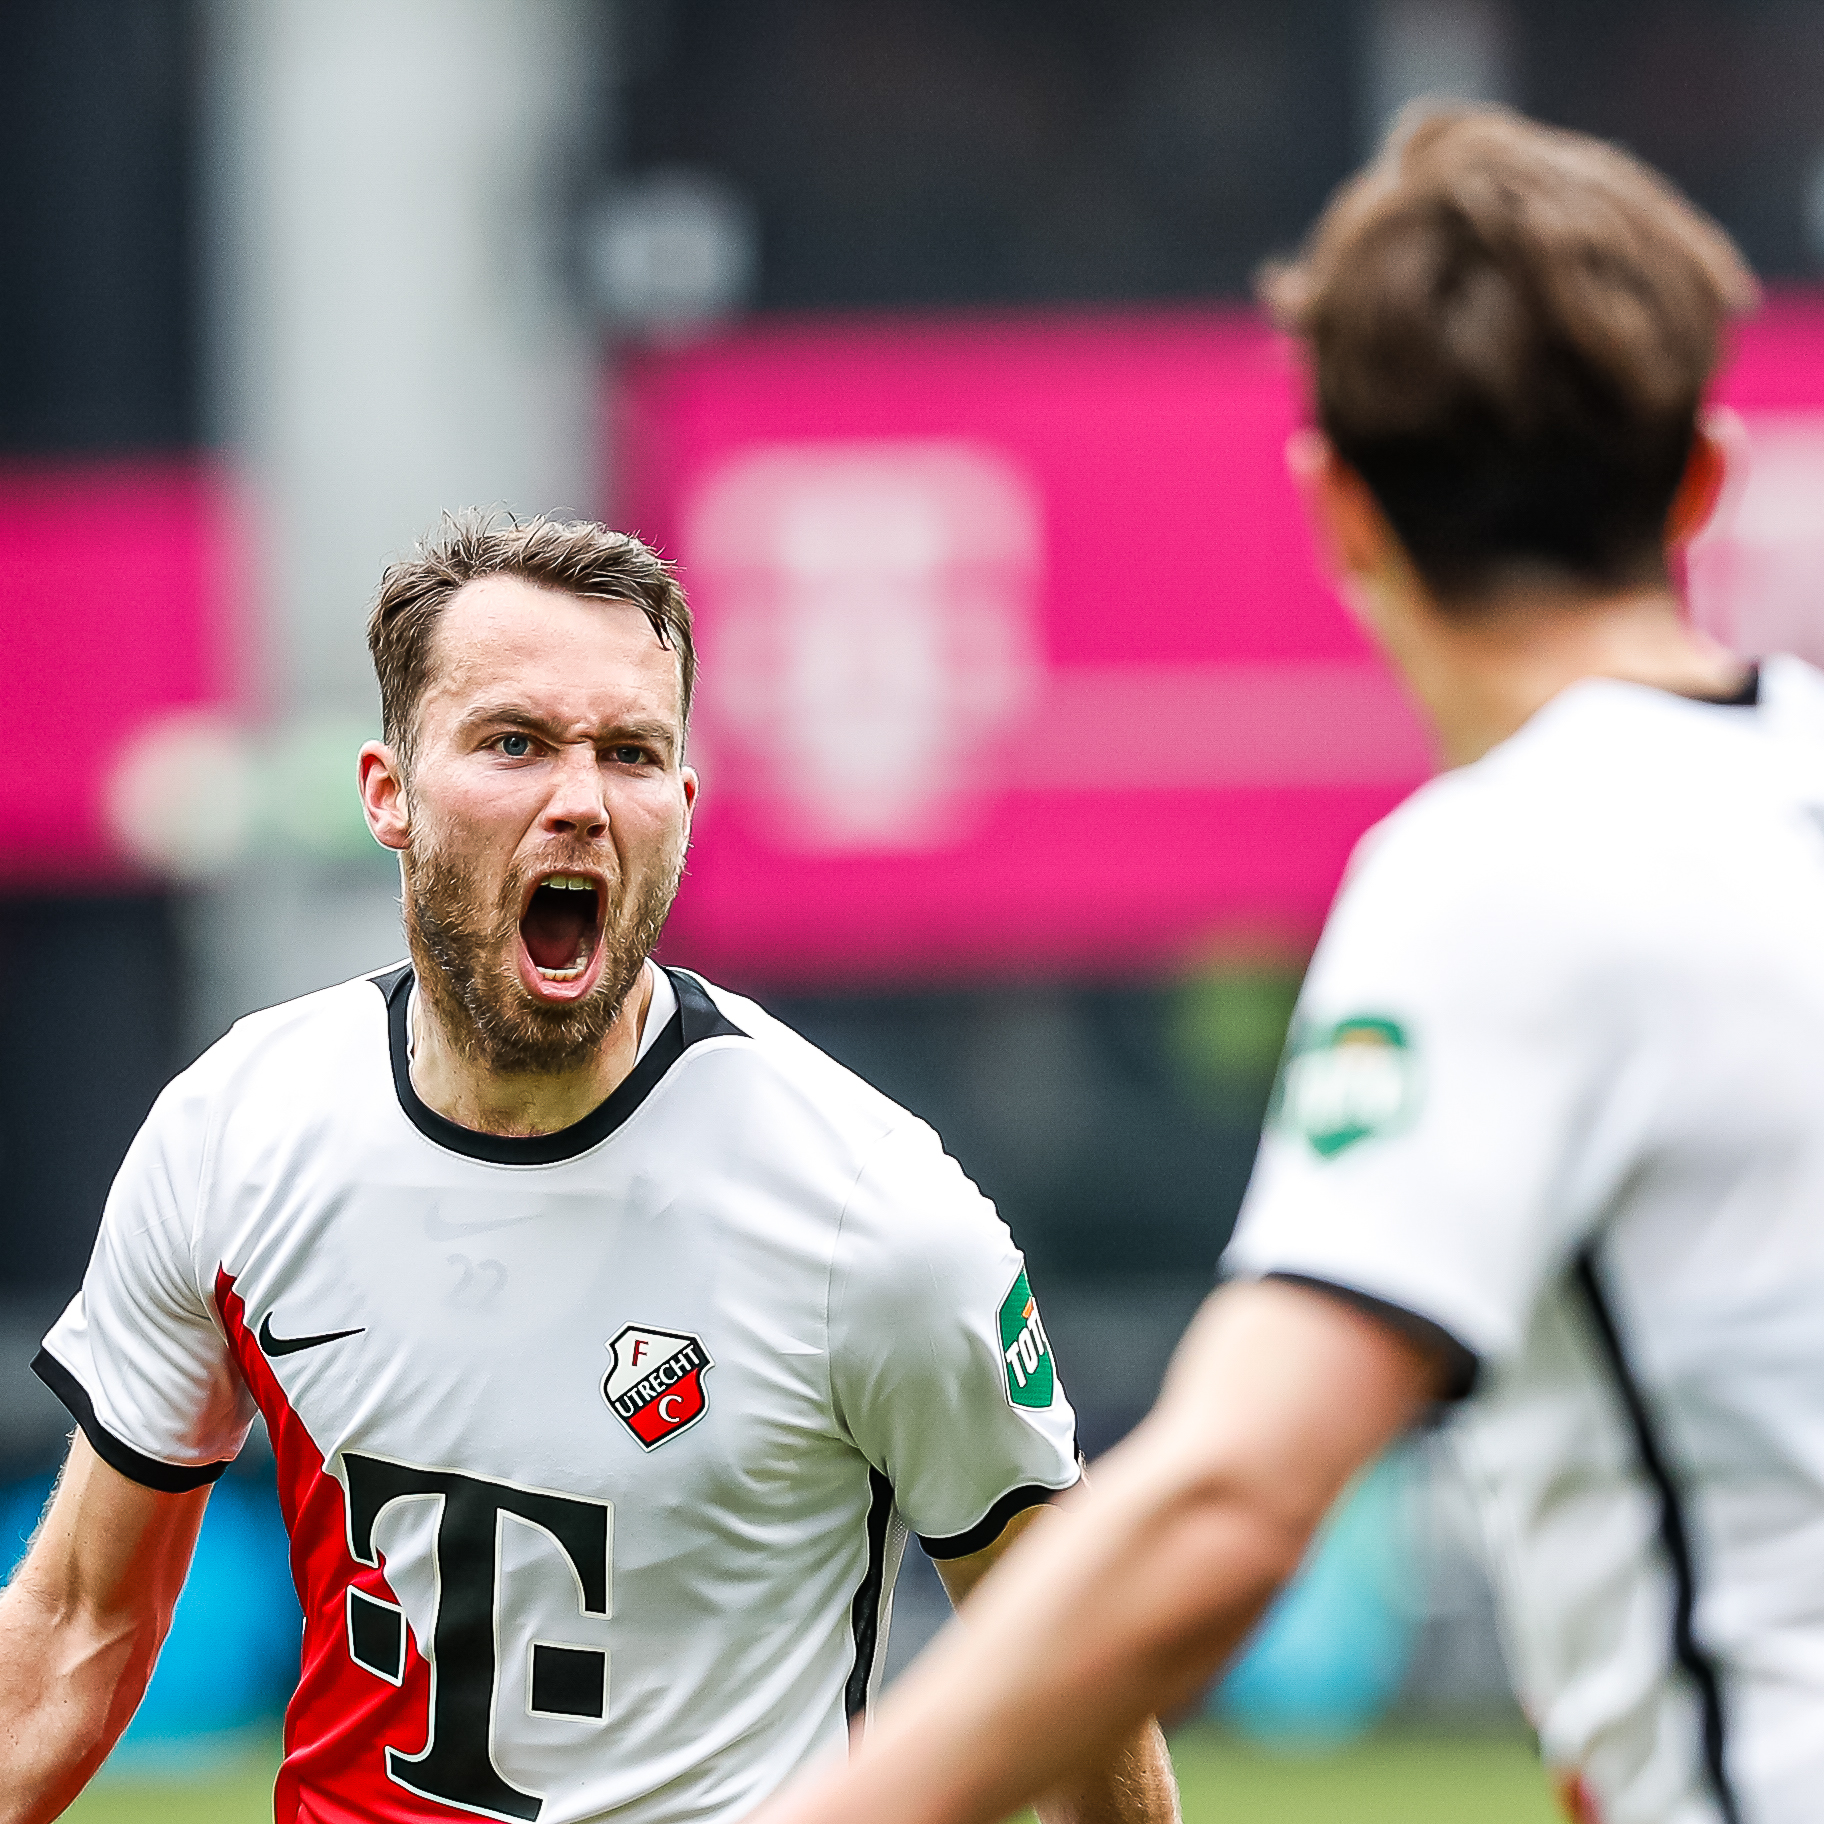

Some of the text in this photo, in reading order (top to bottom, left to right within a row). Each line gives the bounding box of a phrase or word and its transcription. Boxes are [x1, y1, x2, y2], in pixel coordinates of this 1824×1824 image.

[631, 1338, 650, 1367] F
[614, 1344, 700, 1418] UTRECHT
[658, 1394, 683, 1423] C
[342, 1452, 613, 1822] T
